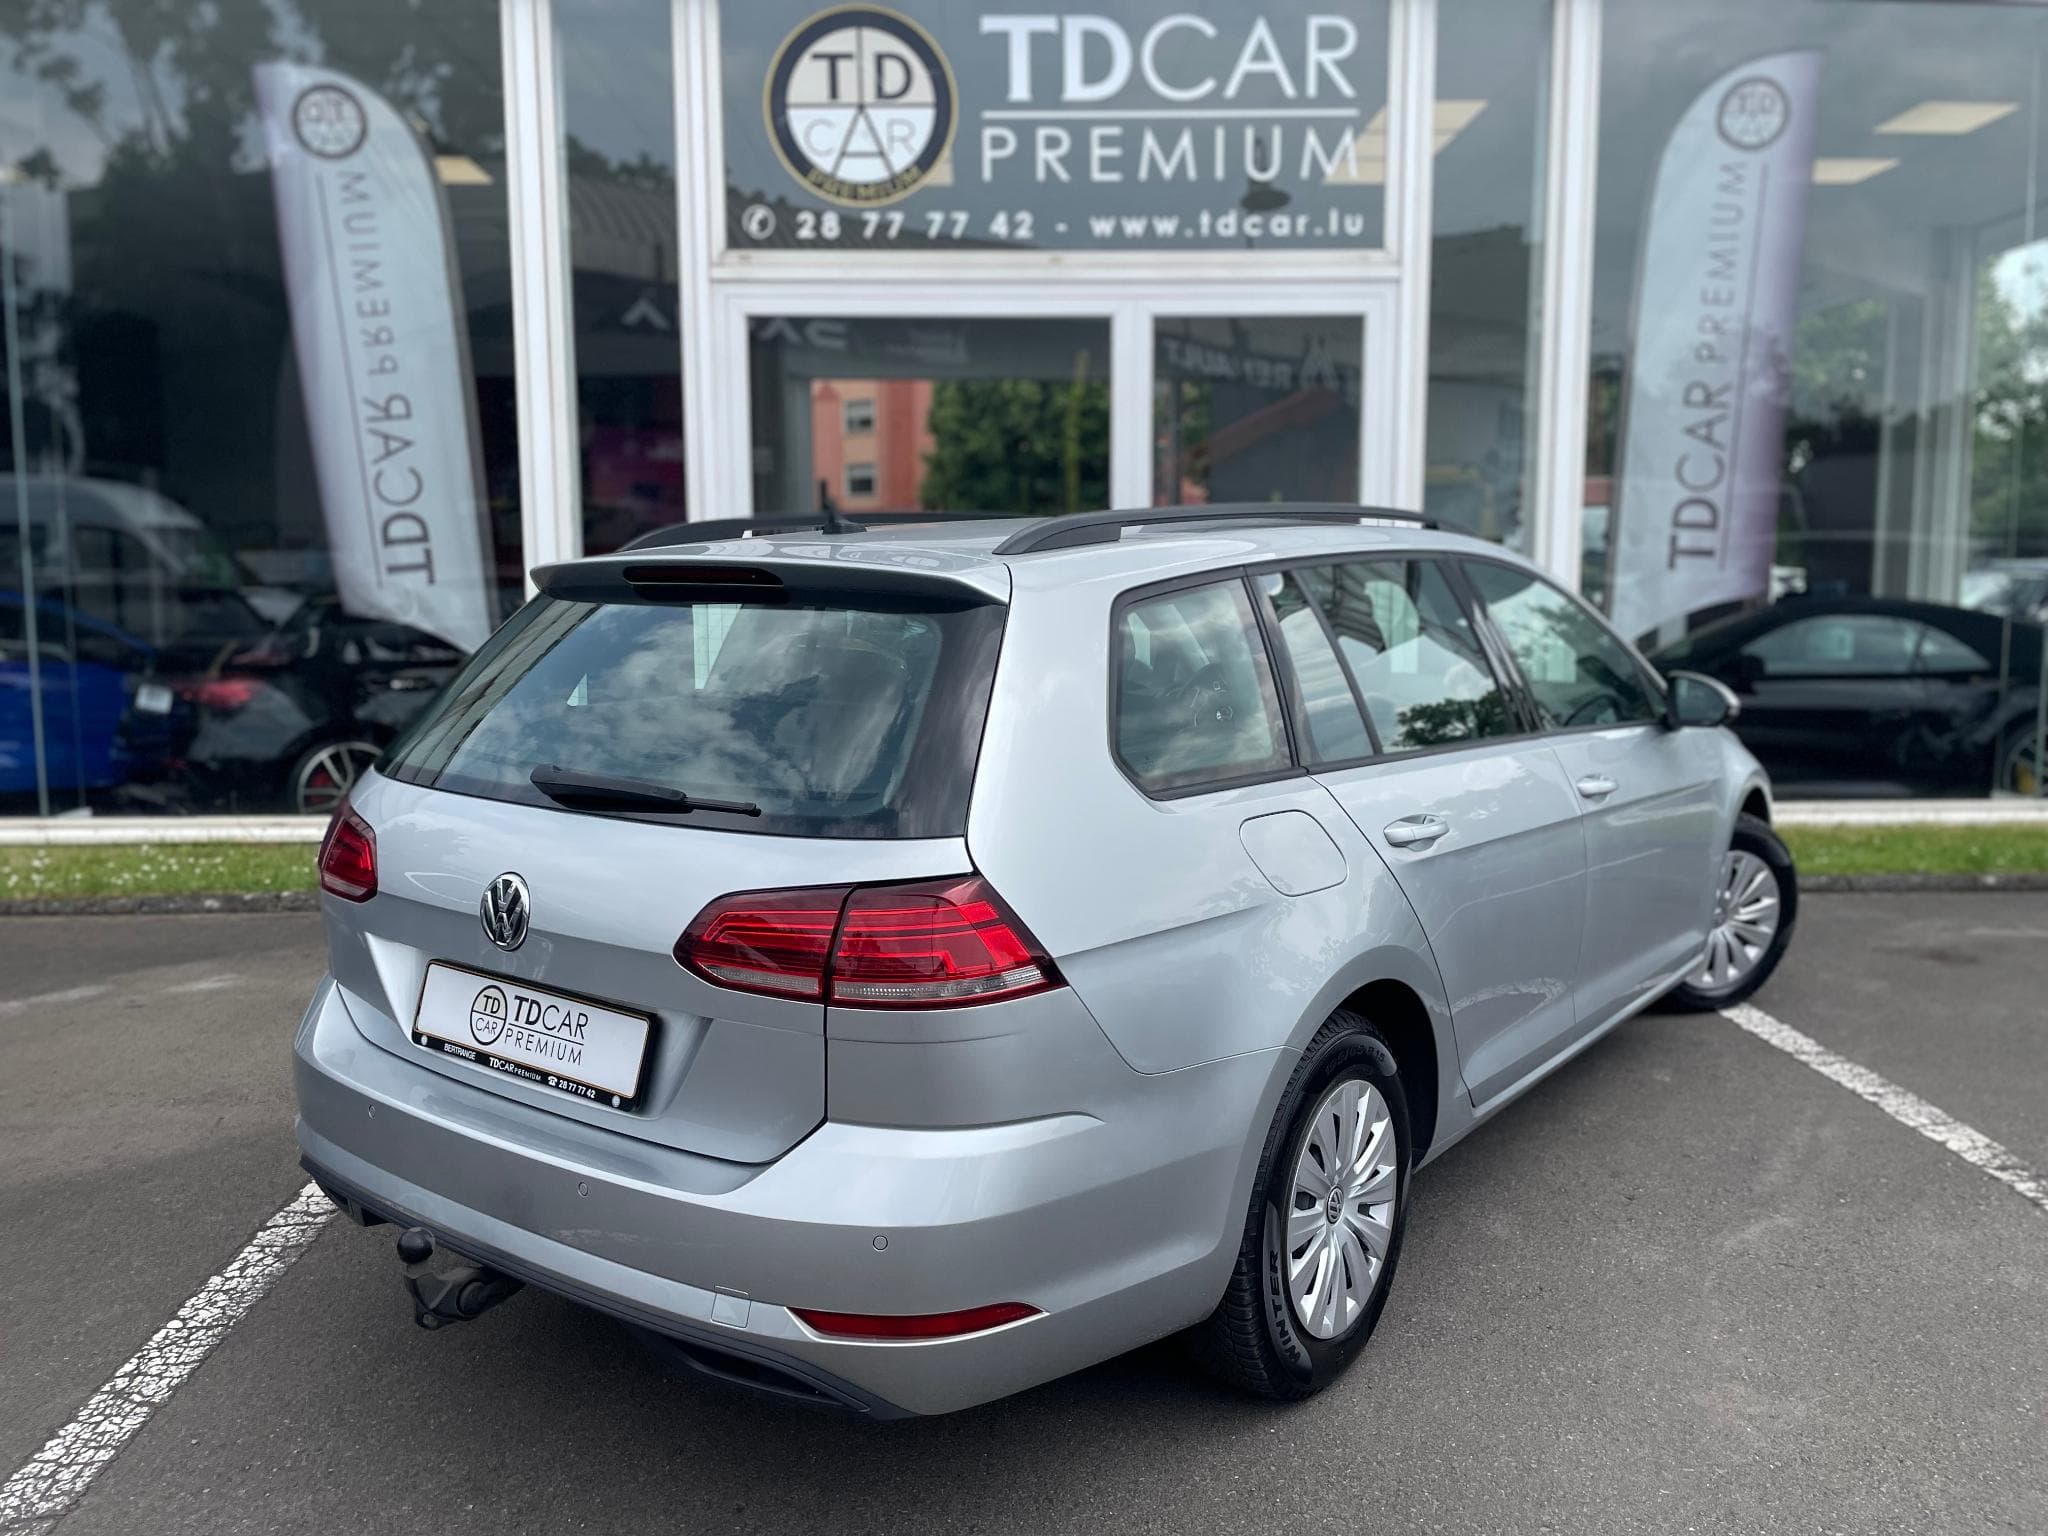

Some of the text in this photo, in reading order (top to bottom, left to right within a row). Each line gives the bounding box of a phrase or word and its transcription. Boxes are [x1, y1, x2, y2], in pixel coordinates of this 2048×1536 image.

[811, 52, 913, 100] TD
[979, 13, 1359, 102] TDCAR
[981, 124, 1360, 182] PREMIUM
[804, 165, 923, 200] PREMIUM
[795, 210, 841, 240] 28
[860, 210, 904, 240] 77
[925, 210, 970, 240] 77
[989, 210, 1034, 240] 42
[1089, 208, 1364, 238] www.tdcar.lu
[1667, 160, 1750, 571] TDCAR PREMIUM
[483, 994, 501, 1014] TD
[514, 994, 589, 1040] TDCAR
[475, 1017, 498, 1035] CAR
[444, 1043, 477, 1061] BERTRANGE
[504, 1027, 583, 1066] PREMIUM
[488, 1056, 542, 1082] TDCAR PREMIUM
[558, 1079, 596, 1099] 28 77 77 42
[1269, 1249, 1301, 1361] WINTER
